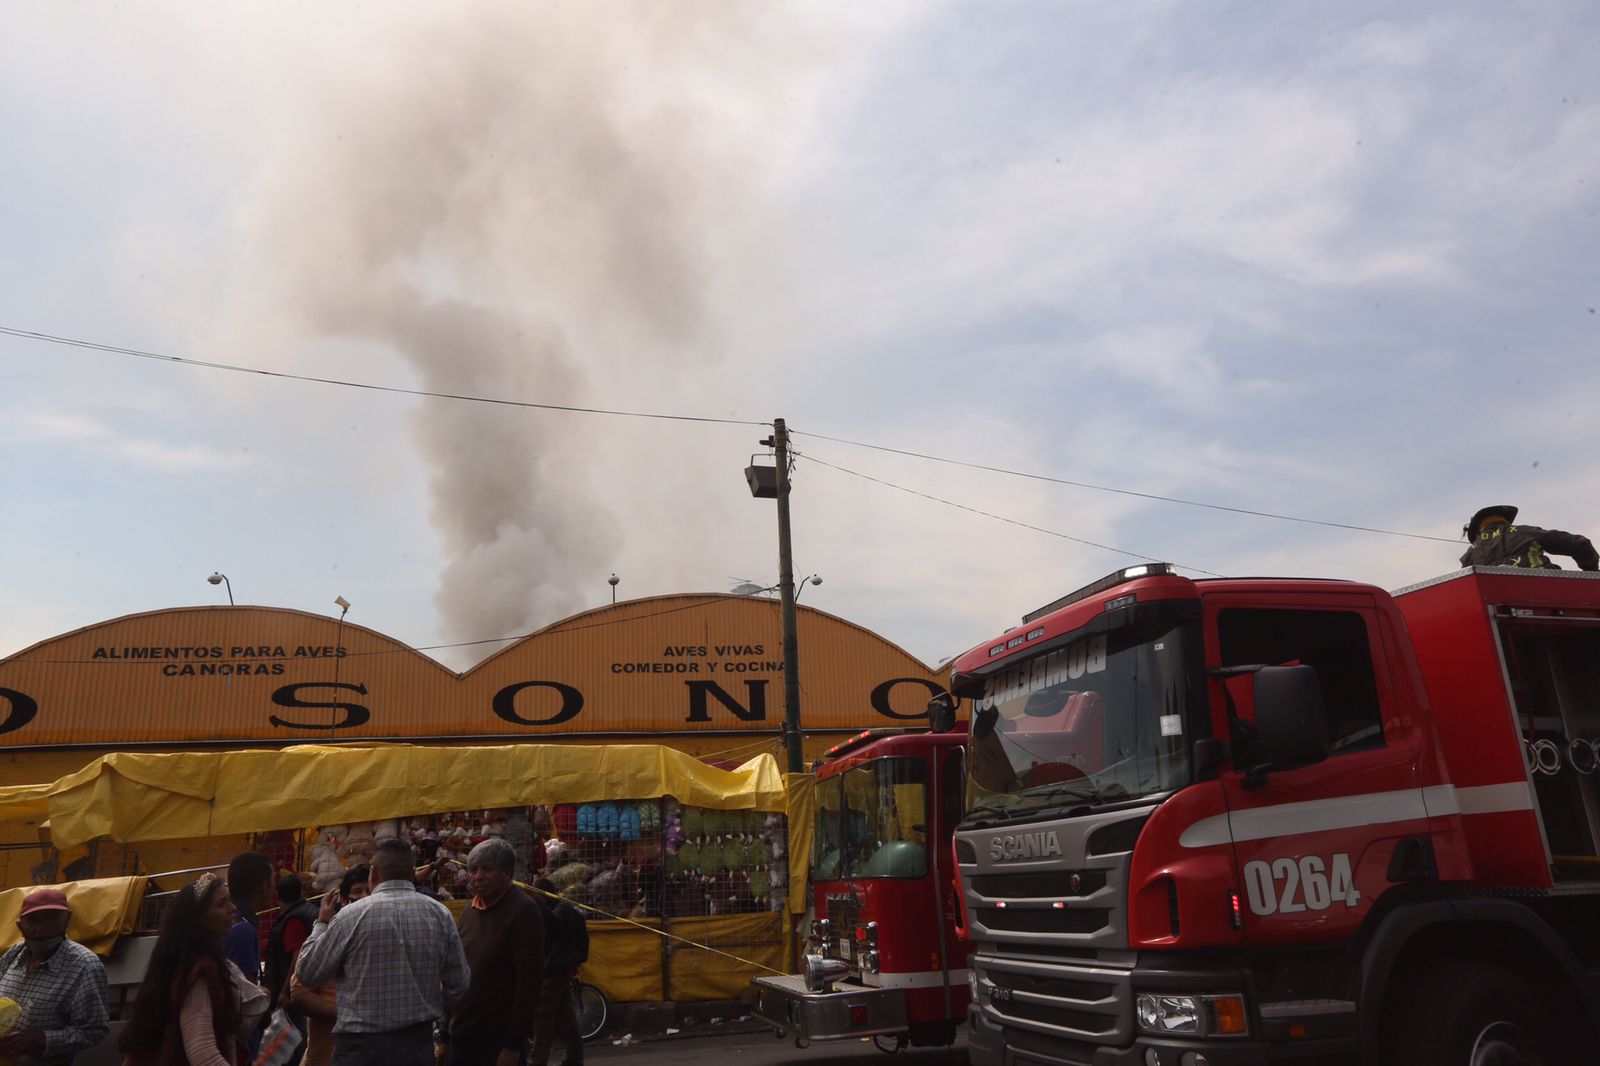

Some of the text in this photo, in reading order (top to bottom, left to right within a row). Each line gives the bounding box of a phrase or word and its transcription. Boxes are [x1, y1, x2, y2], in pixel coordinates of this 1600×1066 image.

[92, 646, 347, 660] ALIMENTOS PARA AVES
[663, 644, 764, 657] AVES VIVAS
[162, 663, 286, 677] CANORAS
[611, 662, 700, 674] COMEDOR
[707, 662, 718, 673] Y
[989, 831, 1063, 862] SCANIA
[1243, 853, 1361, 917] 0264
